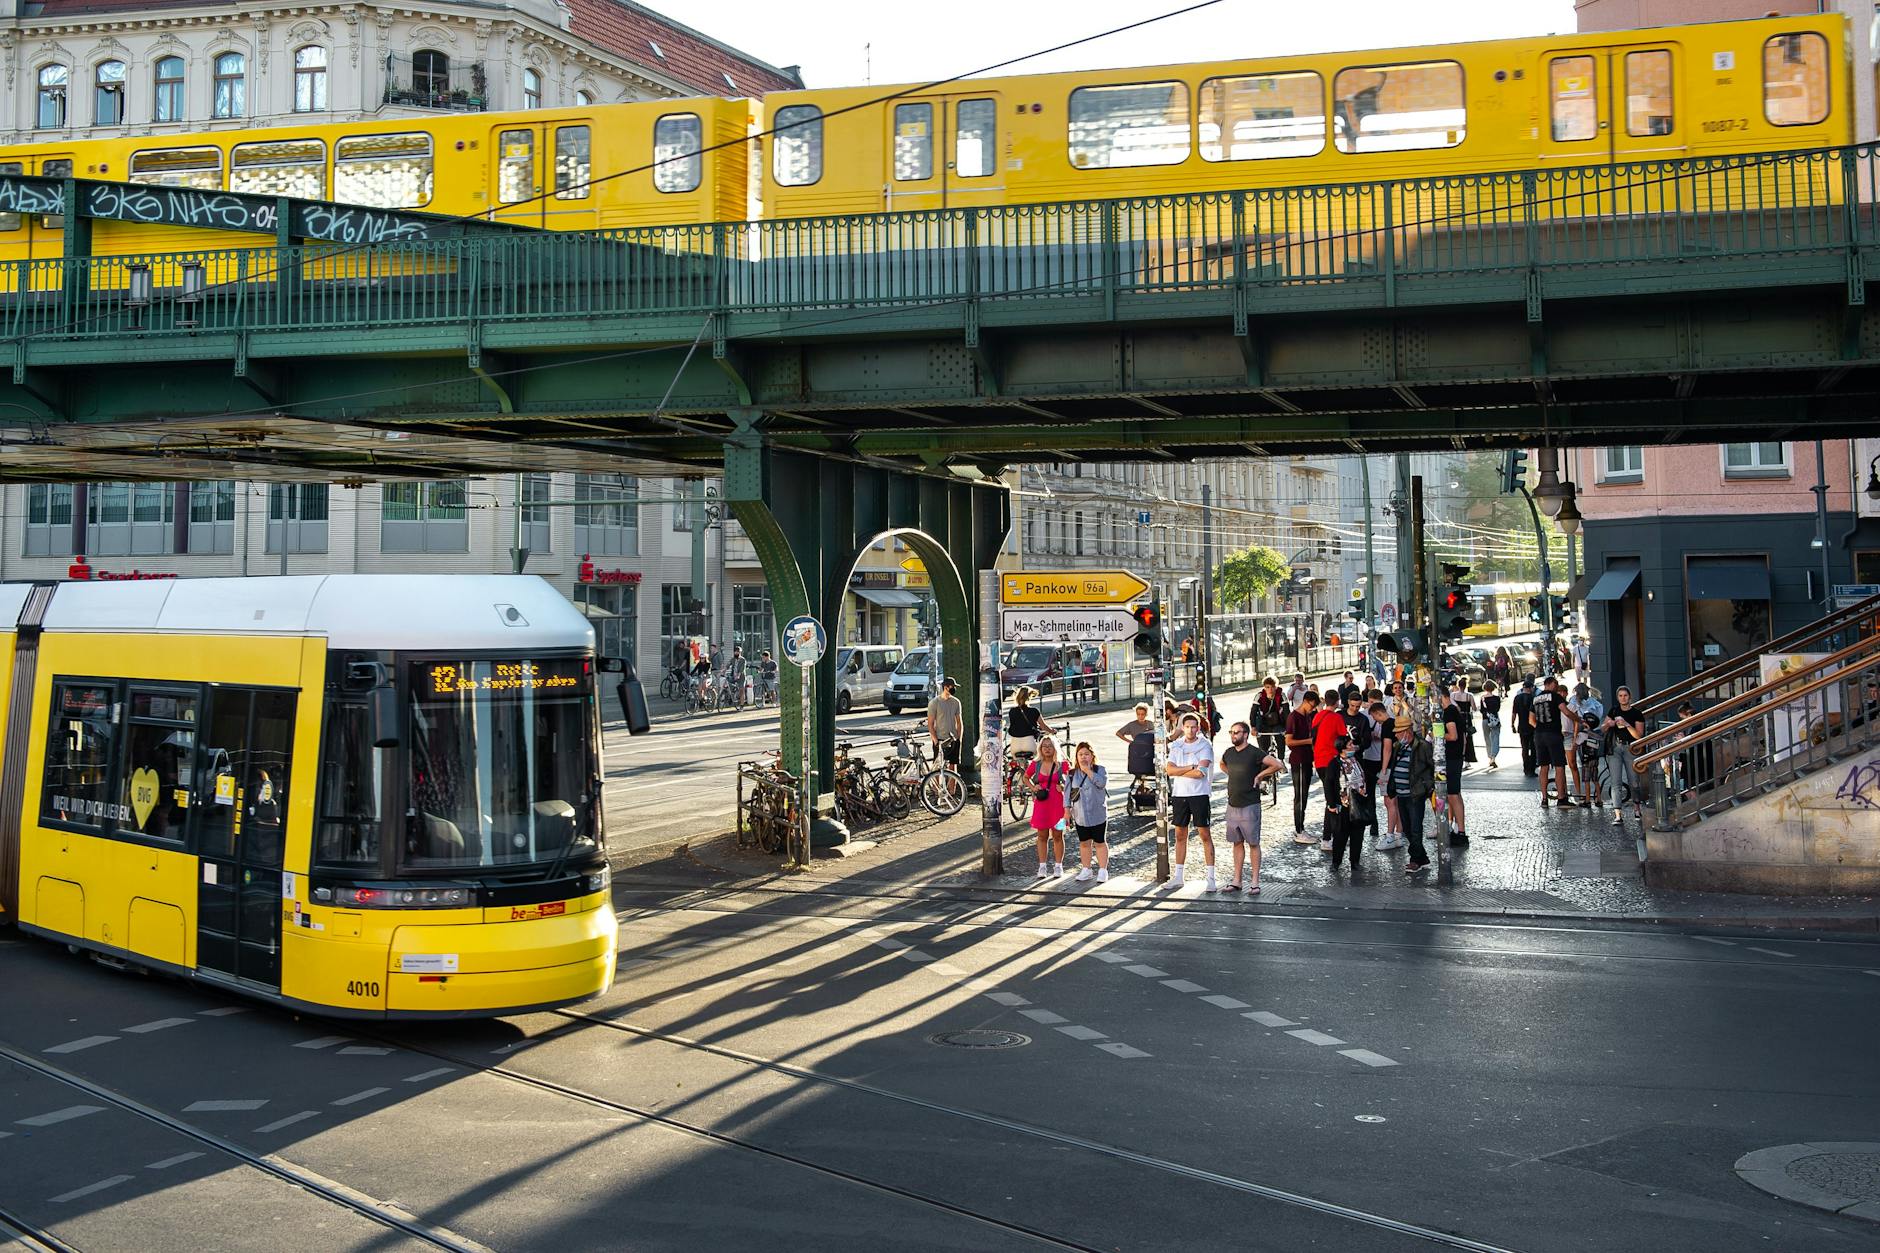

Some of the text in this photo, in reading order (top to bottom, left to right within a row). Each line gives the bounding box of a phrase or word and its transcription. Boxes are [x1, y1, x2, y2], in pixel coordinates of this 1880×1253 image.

[1025, 582, 1104, 594] Pankow 96a
[1013, 619, 1124, 633] Max-Schmeling-Halle
[137, 786, 152, 804] BVG
[53, 794, 70, 812] WEIL
[71, 797, 85, 814] WIR
[86, 800, 103, 817] DICH
[347, 980, 380, 998] 4010
